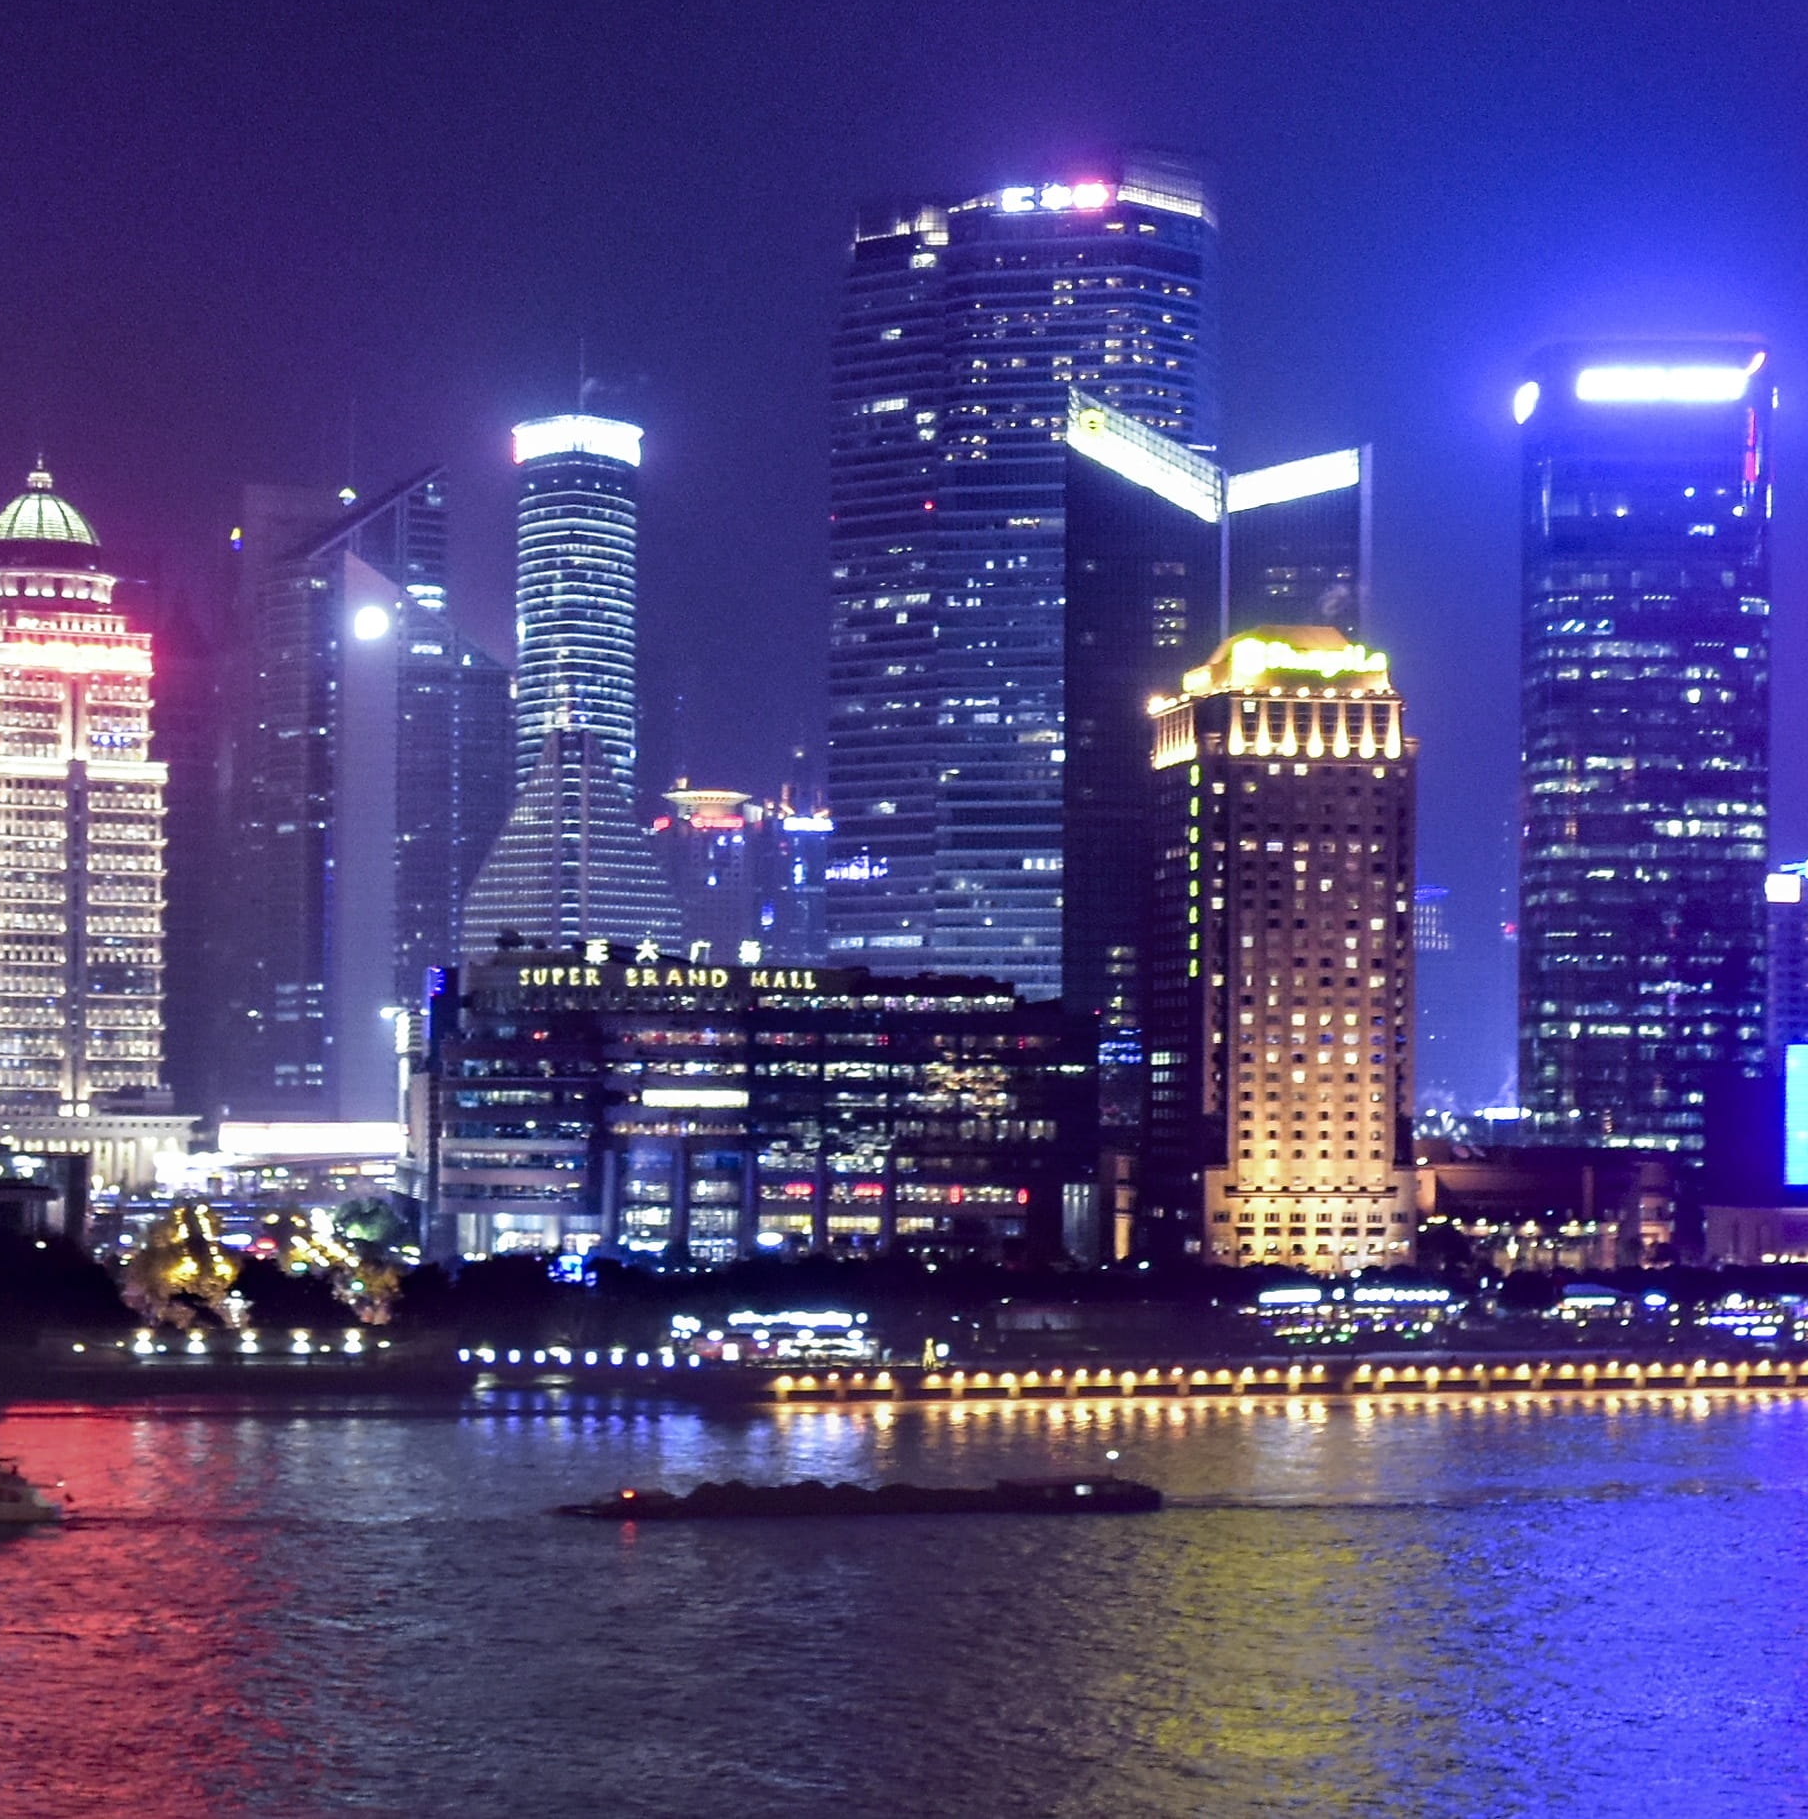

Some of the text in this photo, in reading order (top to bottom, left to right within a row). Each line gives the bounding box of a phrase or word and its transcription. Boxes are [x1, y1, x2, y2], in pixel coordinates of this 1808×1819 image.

[519, 968, 817, 989] SUPER BRAND MALL
